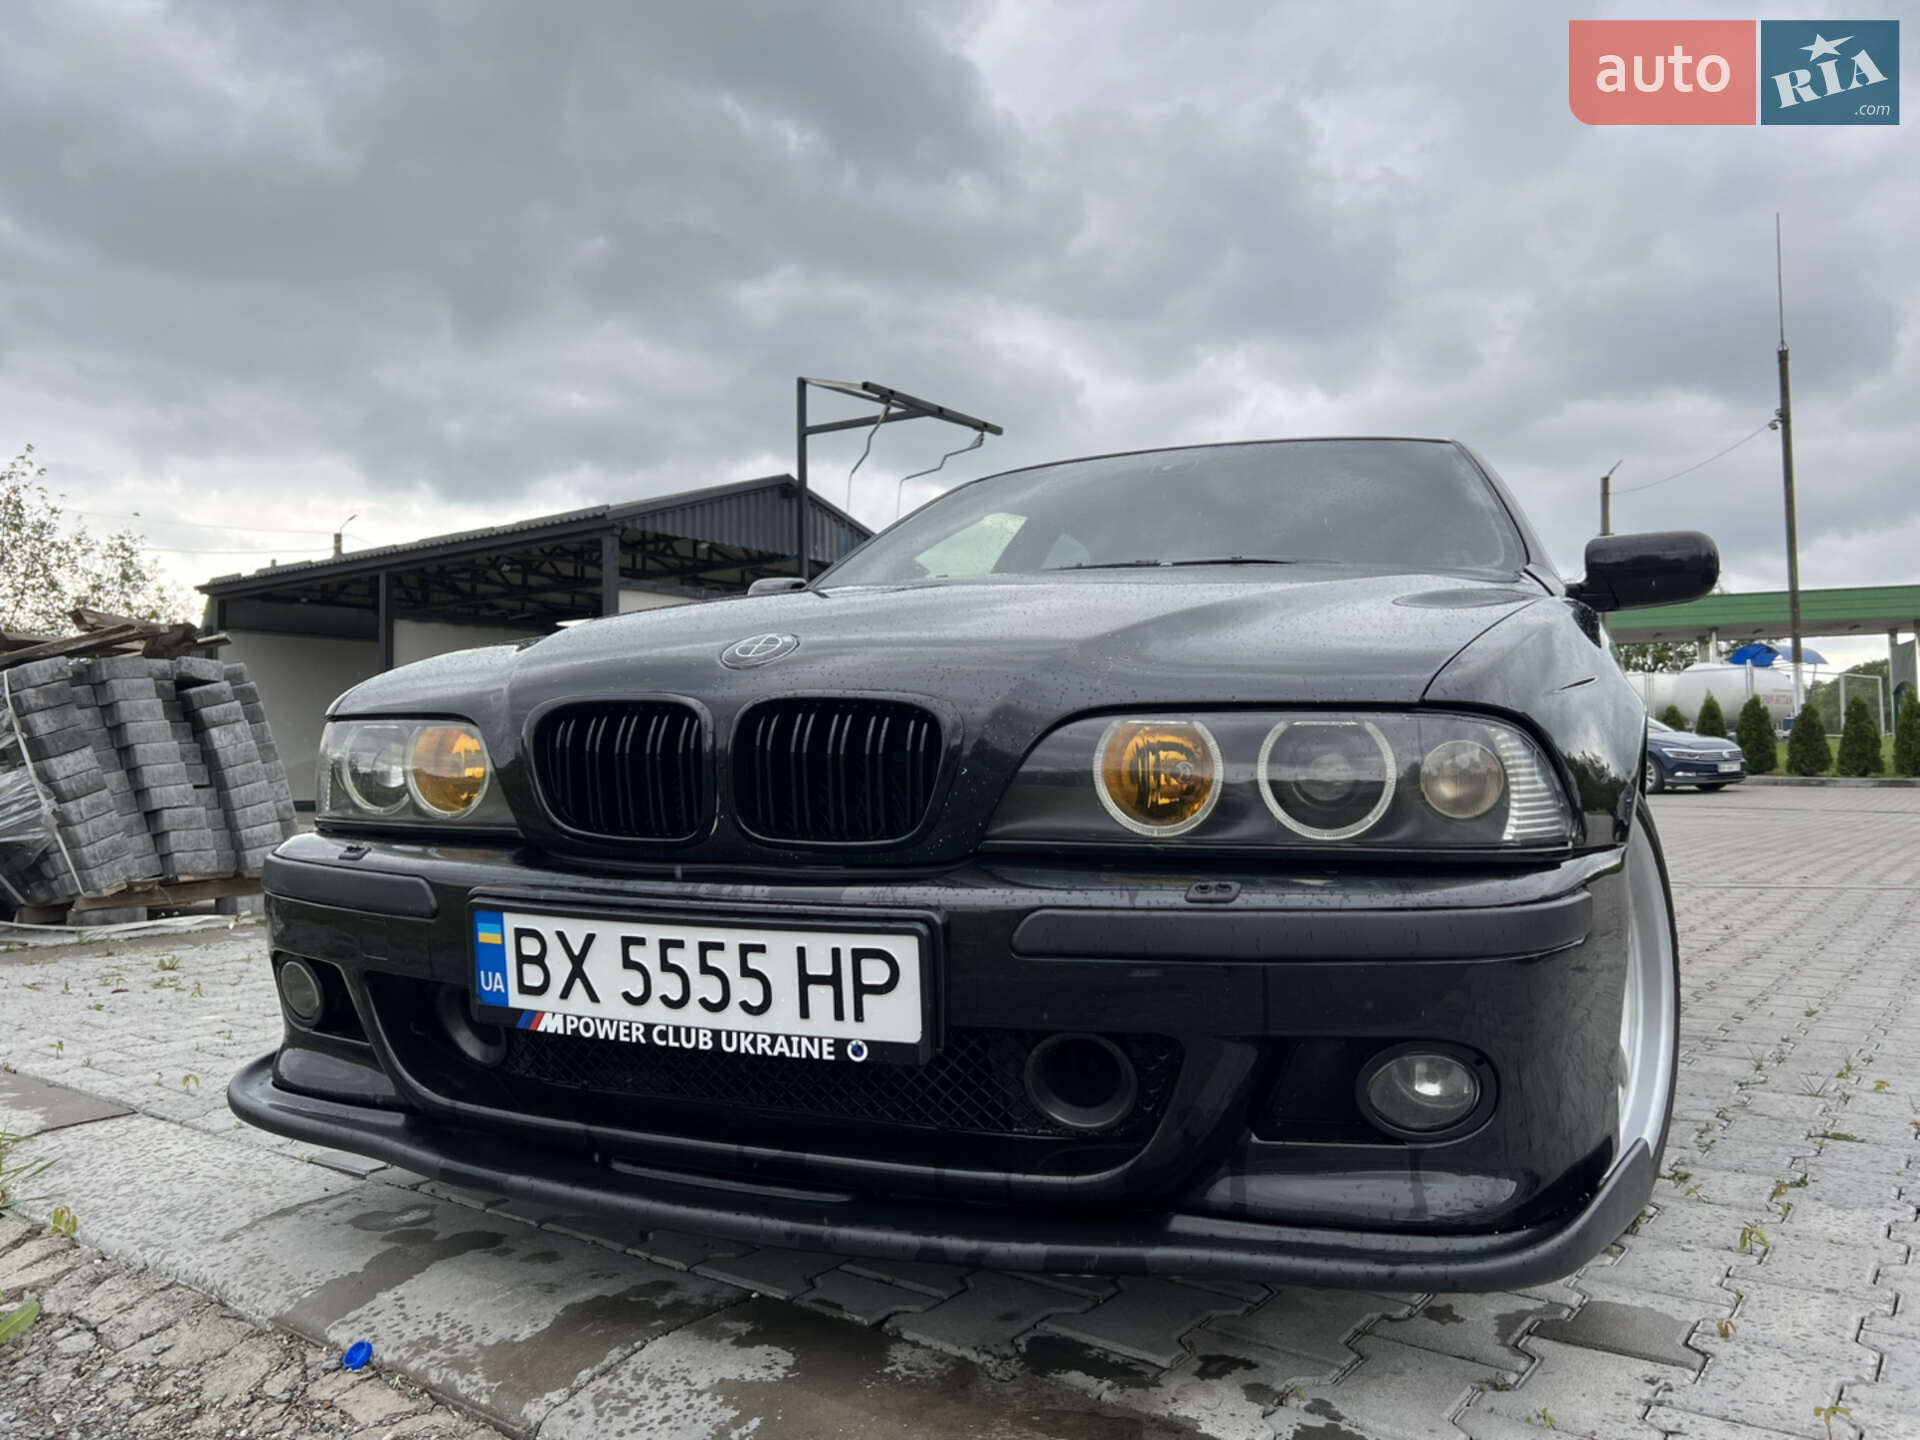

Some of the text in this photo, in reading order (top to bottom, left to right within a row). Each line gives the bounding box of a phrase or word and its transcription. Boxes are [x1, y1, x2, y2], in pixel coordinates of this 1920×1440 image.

[480, 970, 505, 994] UA
[514, 926, 900, 1023] BX 5555 HP
[652, 1024, 713, 1050] CLUB
[720, 1030, 836, 1061] UKRAINE
